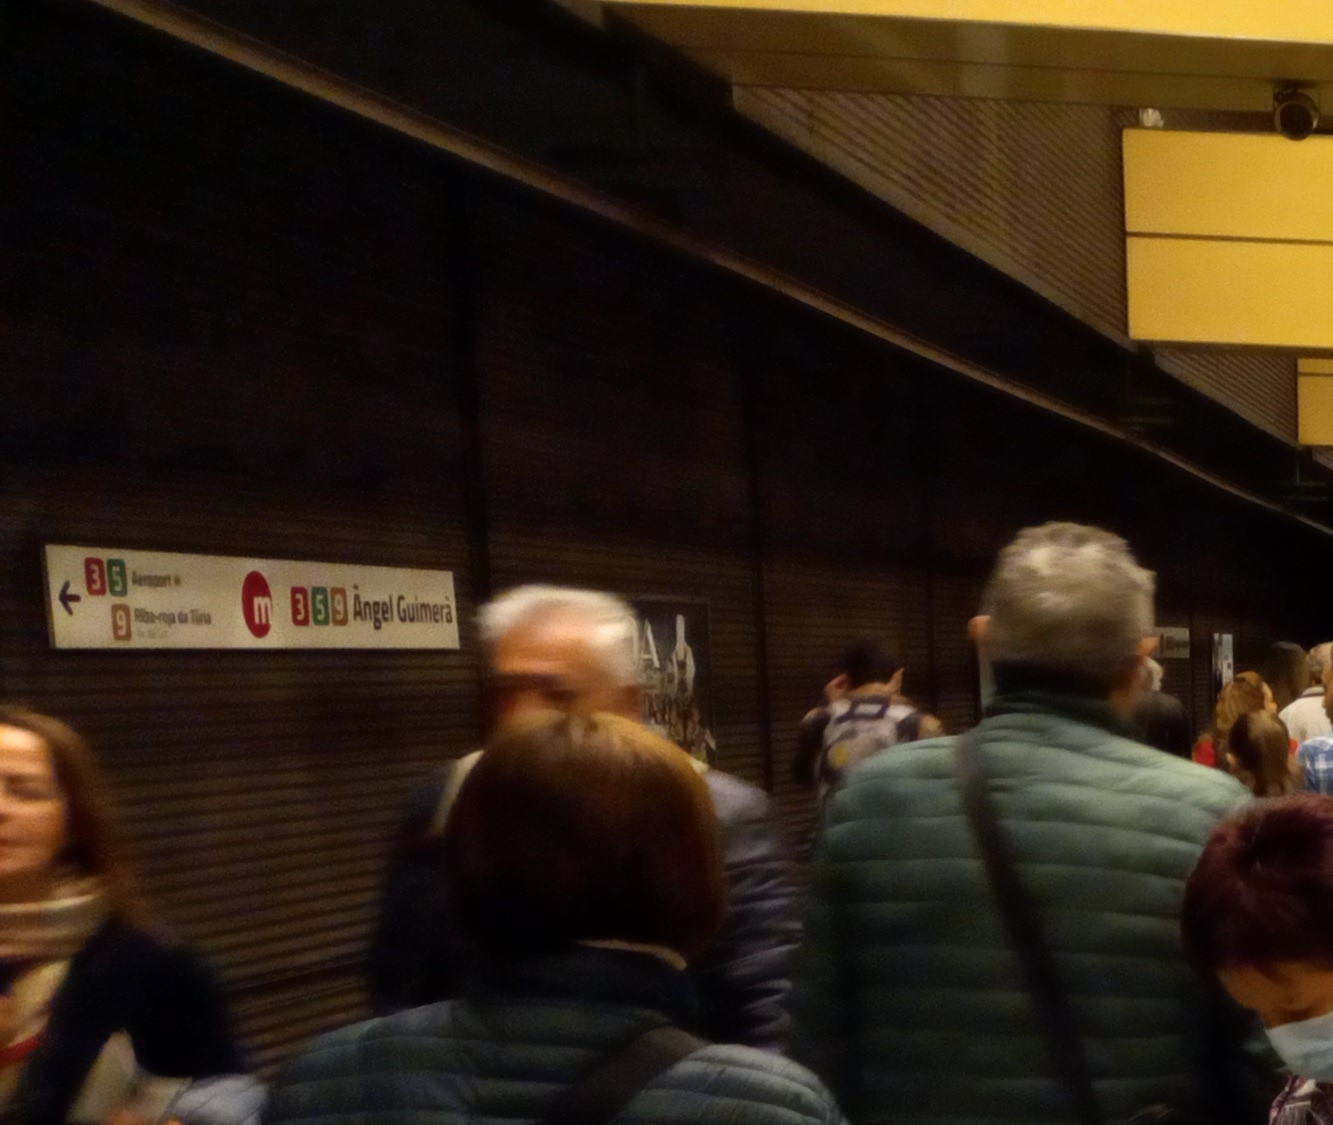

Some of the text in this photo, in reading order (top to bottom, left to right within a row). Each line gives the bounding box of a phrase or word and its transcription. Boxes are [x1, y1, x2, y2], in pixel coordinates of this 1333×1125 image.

[89, 563, 101, 590] 3
[112, 566, 122, 591] 5
[295, 584, 453, 630] 3 5 9 Àngel Guimerà
[116, 610, 127, 636] 9
